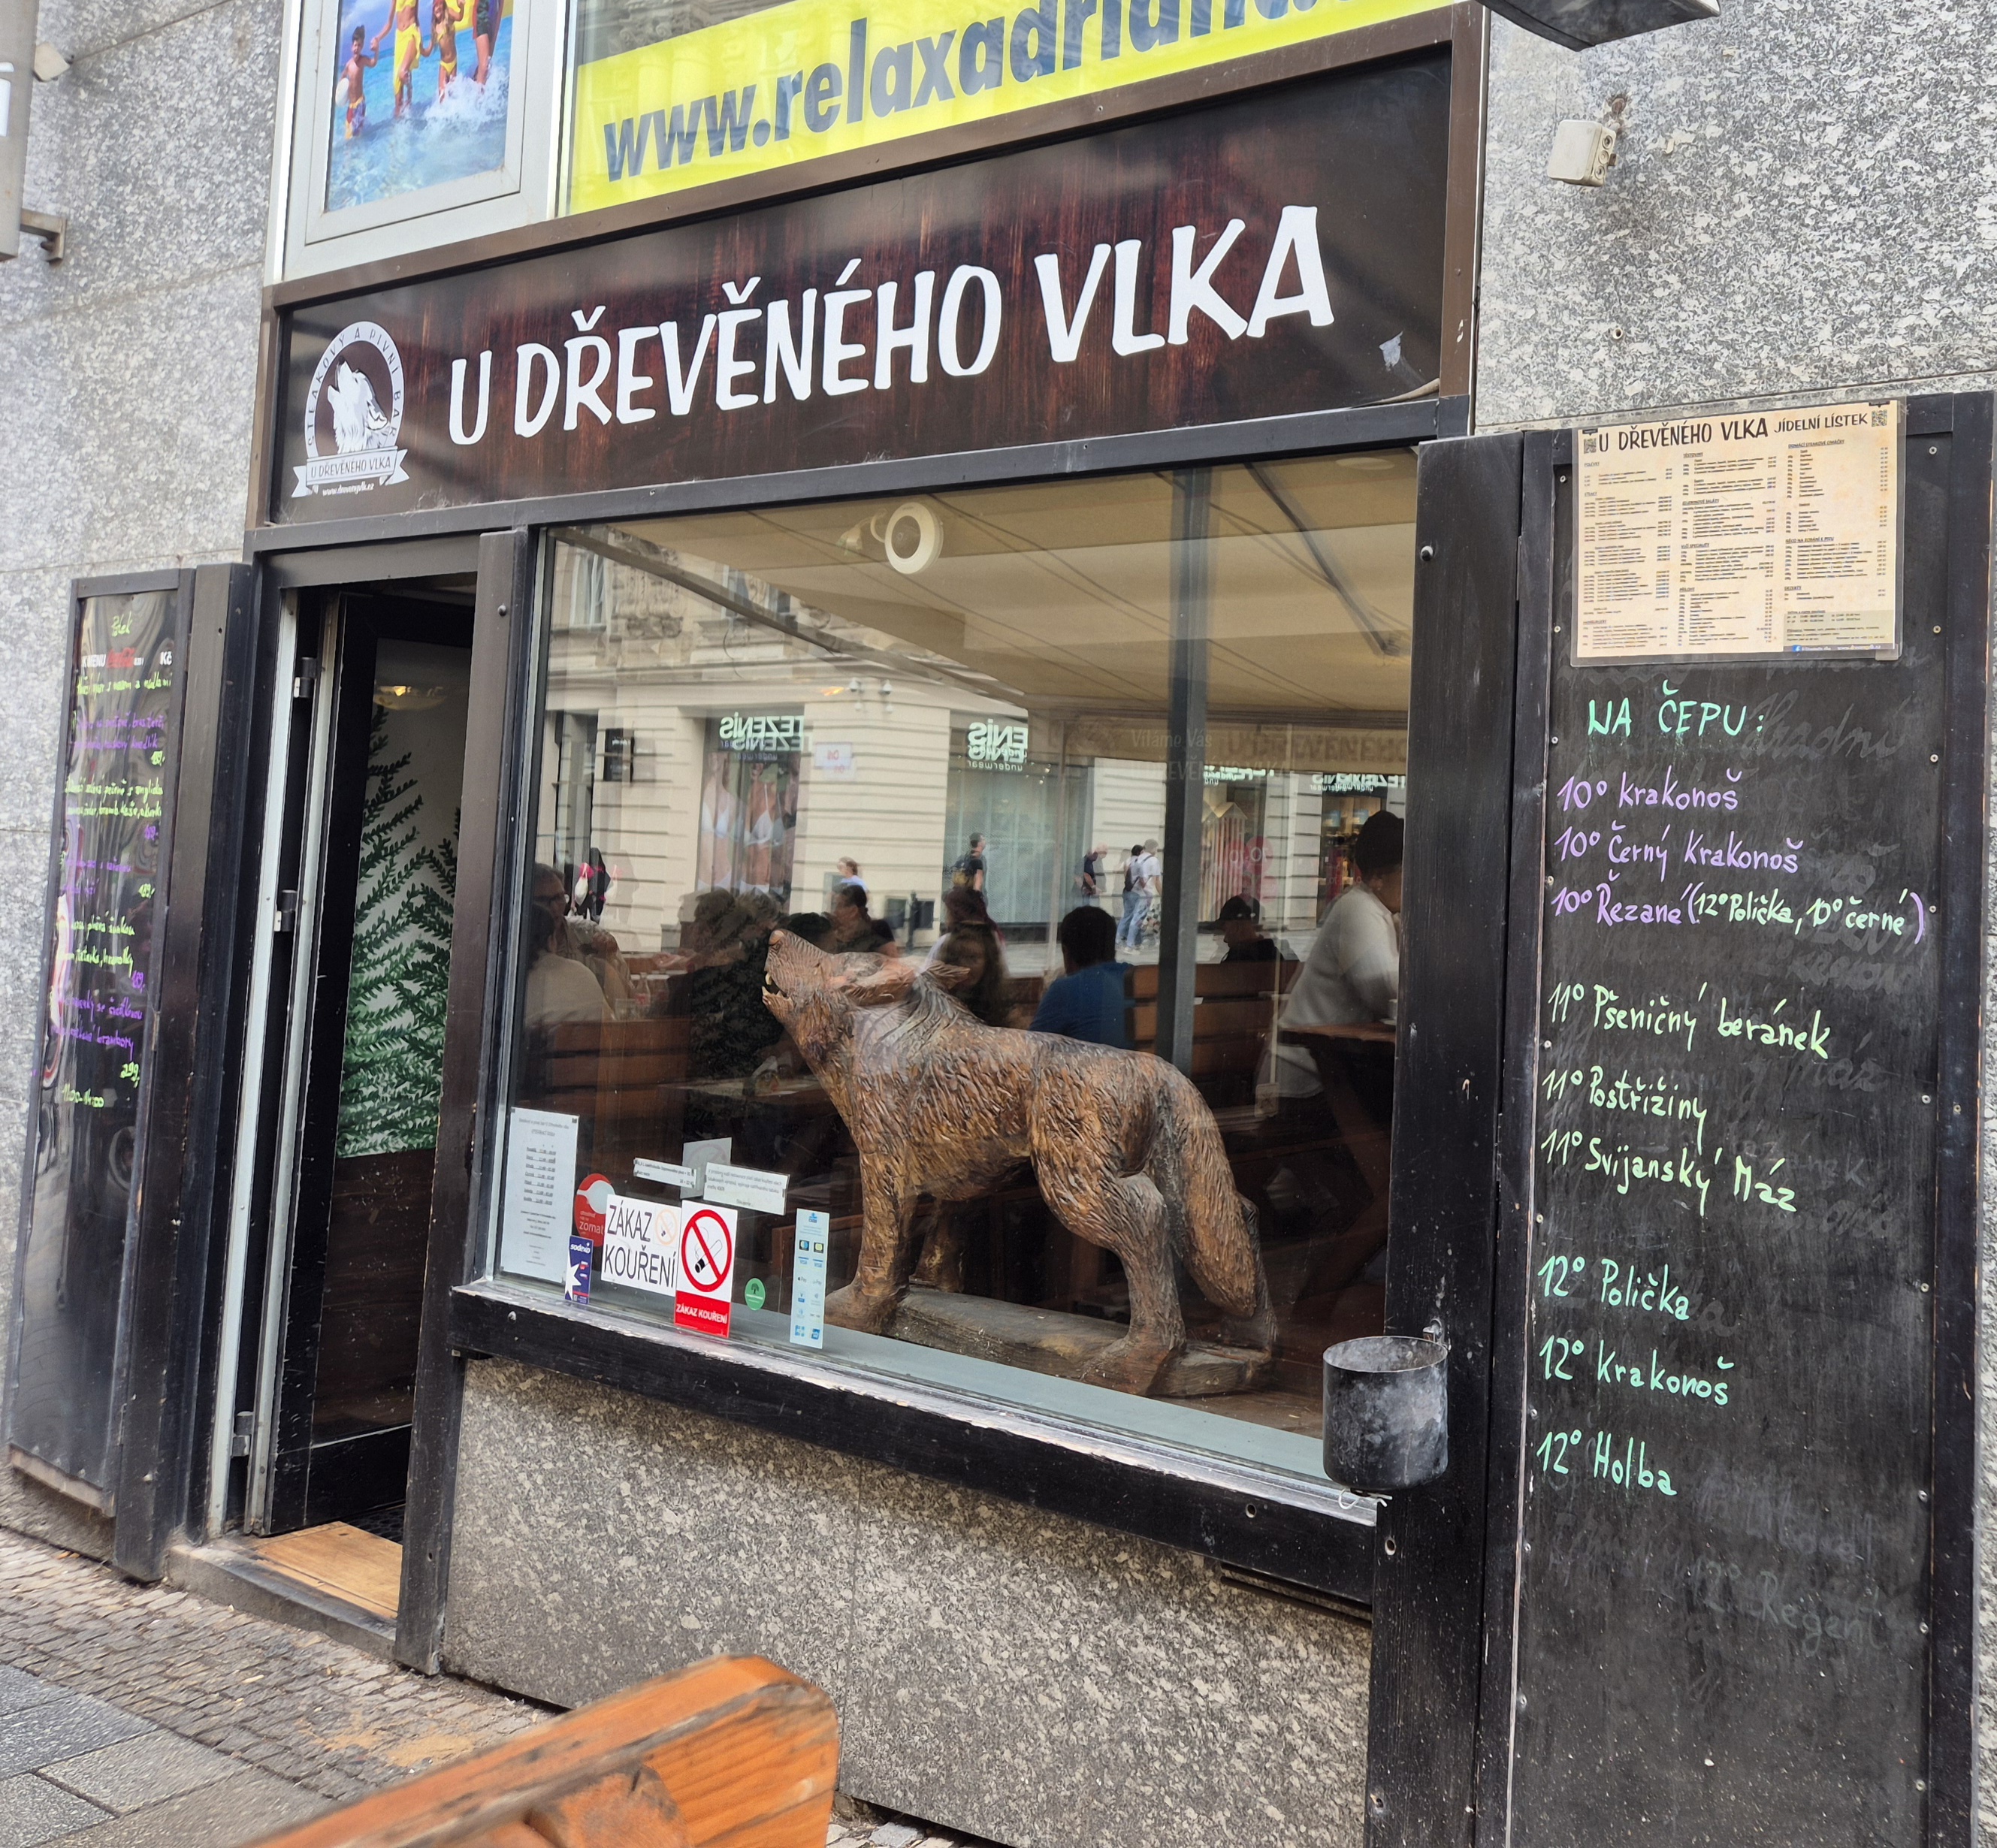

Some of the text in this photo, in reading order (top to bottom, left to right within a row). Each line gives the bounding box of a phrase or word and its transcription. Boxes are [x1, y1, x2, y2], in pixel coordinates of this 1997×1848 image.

[449, 205, 1335, 445] U DŘEVĚNÉHO VLKA
[388, 391, 403, 438] BAR
[1599, 412, 1868, 452] U DŘEVĚNÉHO VLKA JÍDELNÍ LÍSTEK
[311, 456, 391, 479] U DŘEVĚNÉHO VLKA
[1588, 697, 1632, 737] NA
[1608, 820, 1671, 883] Černý
[1594, 981, 1708, 1052] Pšeničný
[1718, 997, 1831, 1060] beránek
[1589, 1065, 1707, 1155] Postřižiny
[1585, 1137, 1723, 1217] Svijanský
[1734, 1157, 1797, 1212] Máz
[607, 1199, 653, 1243] ZÁKAZ
[570, 1243, 591, 1254] sodexo
[604, 1245, 675, 1288] KOUŘENÍ
[1600, 1258, 1690, 1321] Polička
[676, 1303, 728, 1324] ZÁKAZ KOUŘENÍ
[1594, 1430, 1678, 1496] Holba
